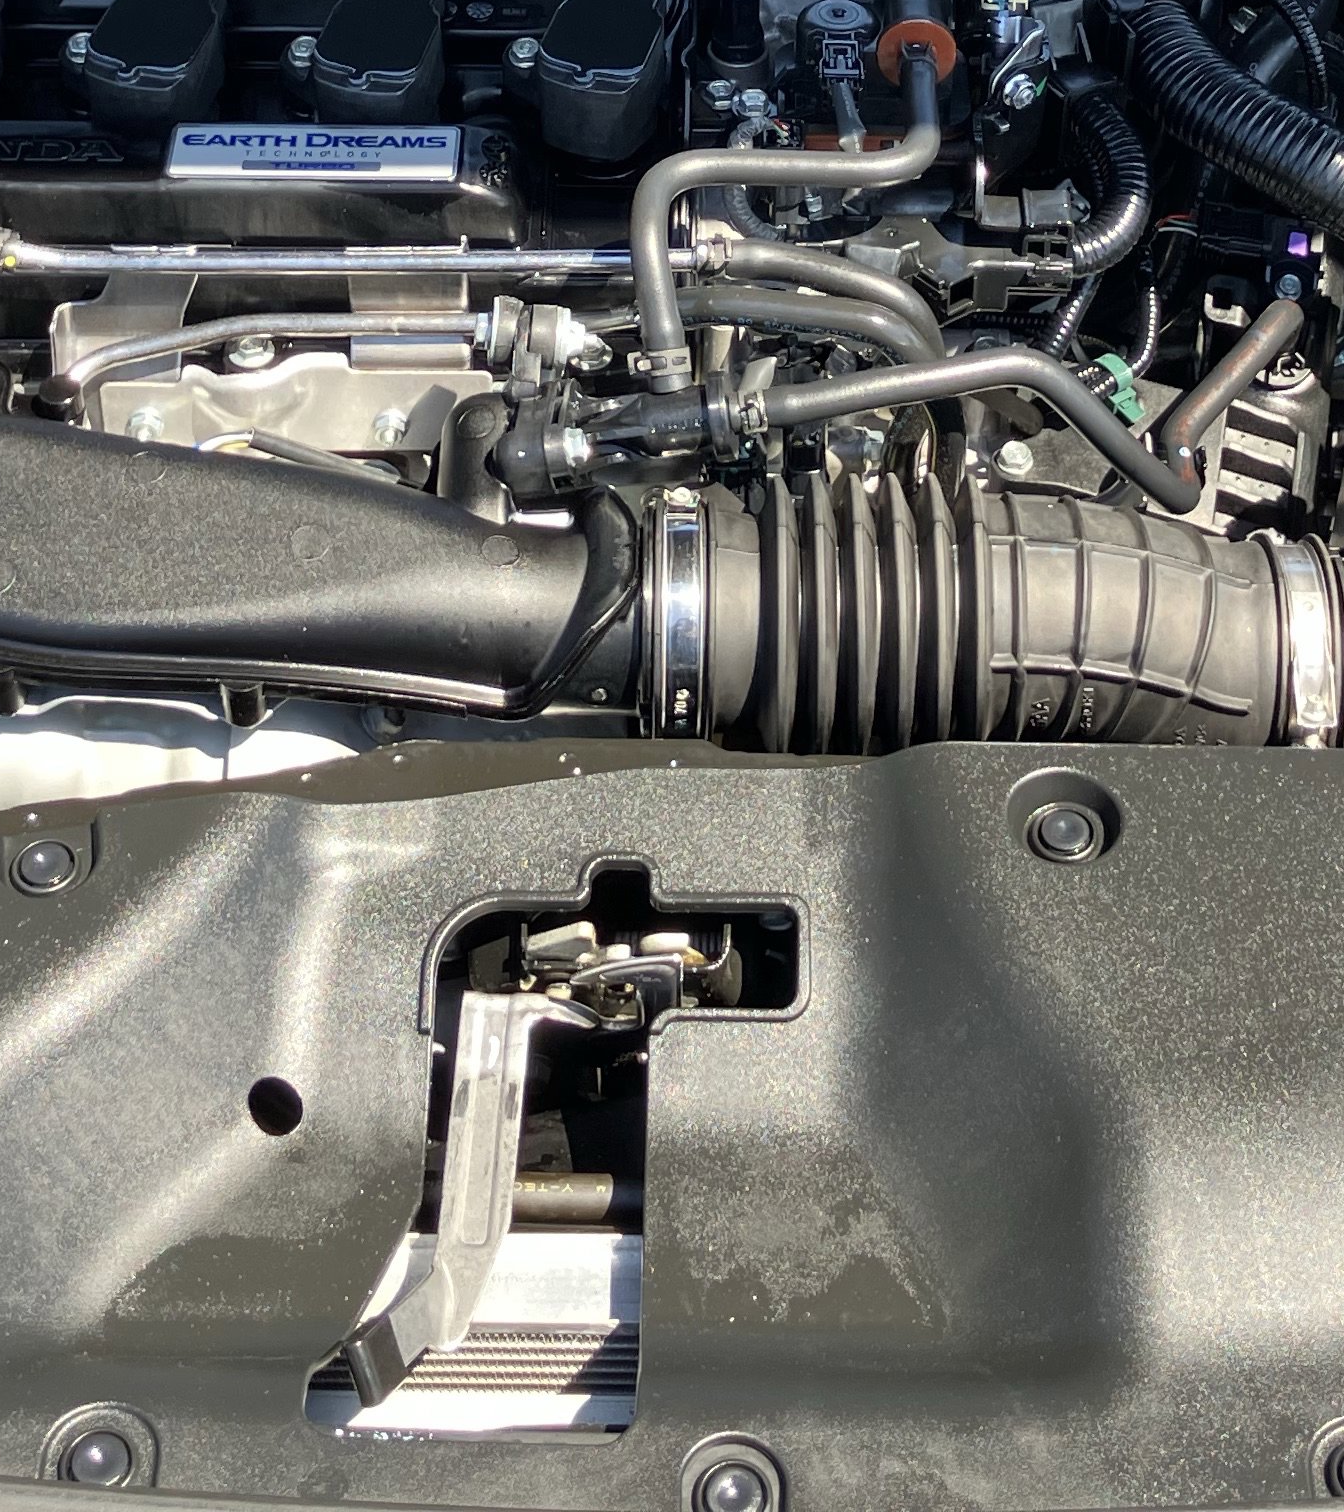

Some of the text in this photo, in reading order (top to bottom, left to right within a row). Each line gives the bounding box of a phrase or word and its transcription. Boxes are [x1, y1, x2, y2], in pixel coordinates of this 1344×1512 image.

[182, 132, 447, 149] EARTH DREAMS
[245, 150, 382, 159] TECHNOLOGY
[514, 1181, 574, 1193] Y-TEC
